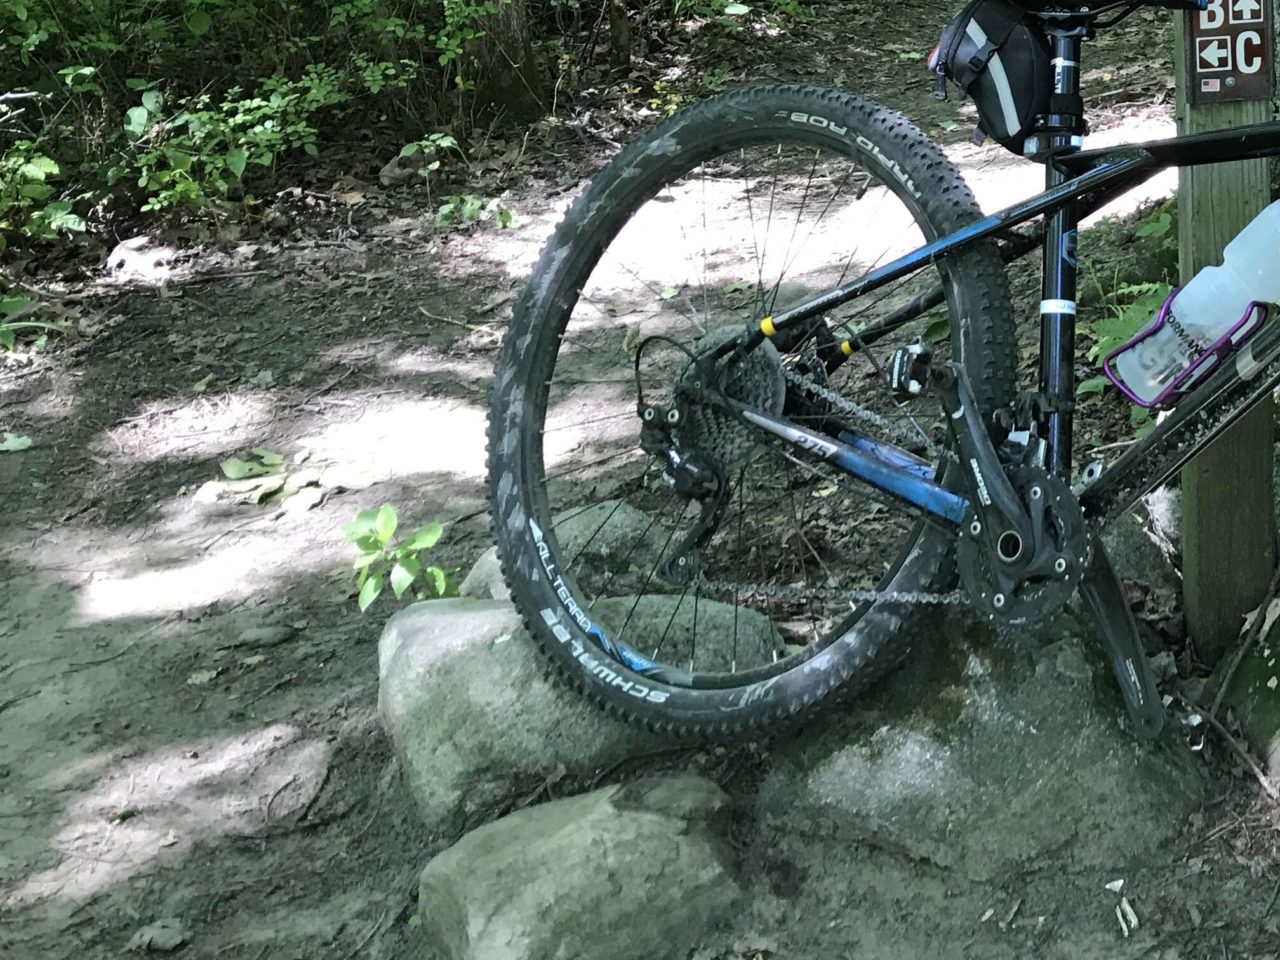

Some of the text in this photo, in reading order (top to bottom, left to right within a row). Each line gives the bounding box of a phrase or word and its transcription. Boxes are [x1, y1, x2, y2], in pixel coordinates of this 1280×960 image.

[1235, 30, 1262, 74] C
[790, 112, 921, 199] RAPID ROB
[536, 542, 593, 632] ALL TERRA
[540, 607, 670, 704] SCHWALBE
